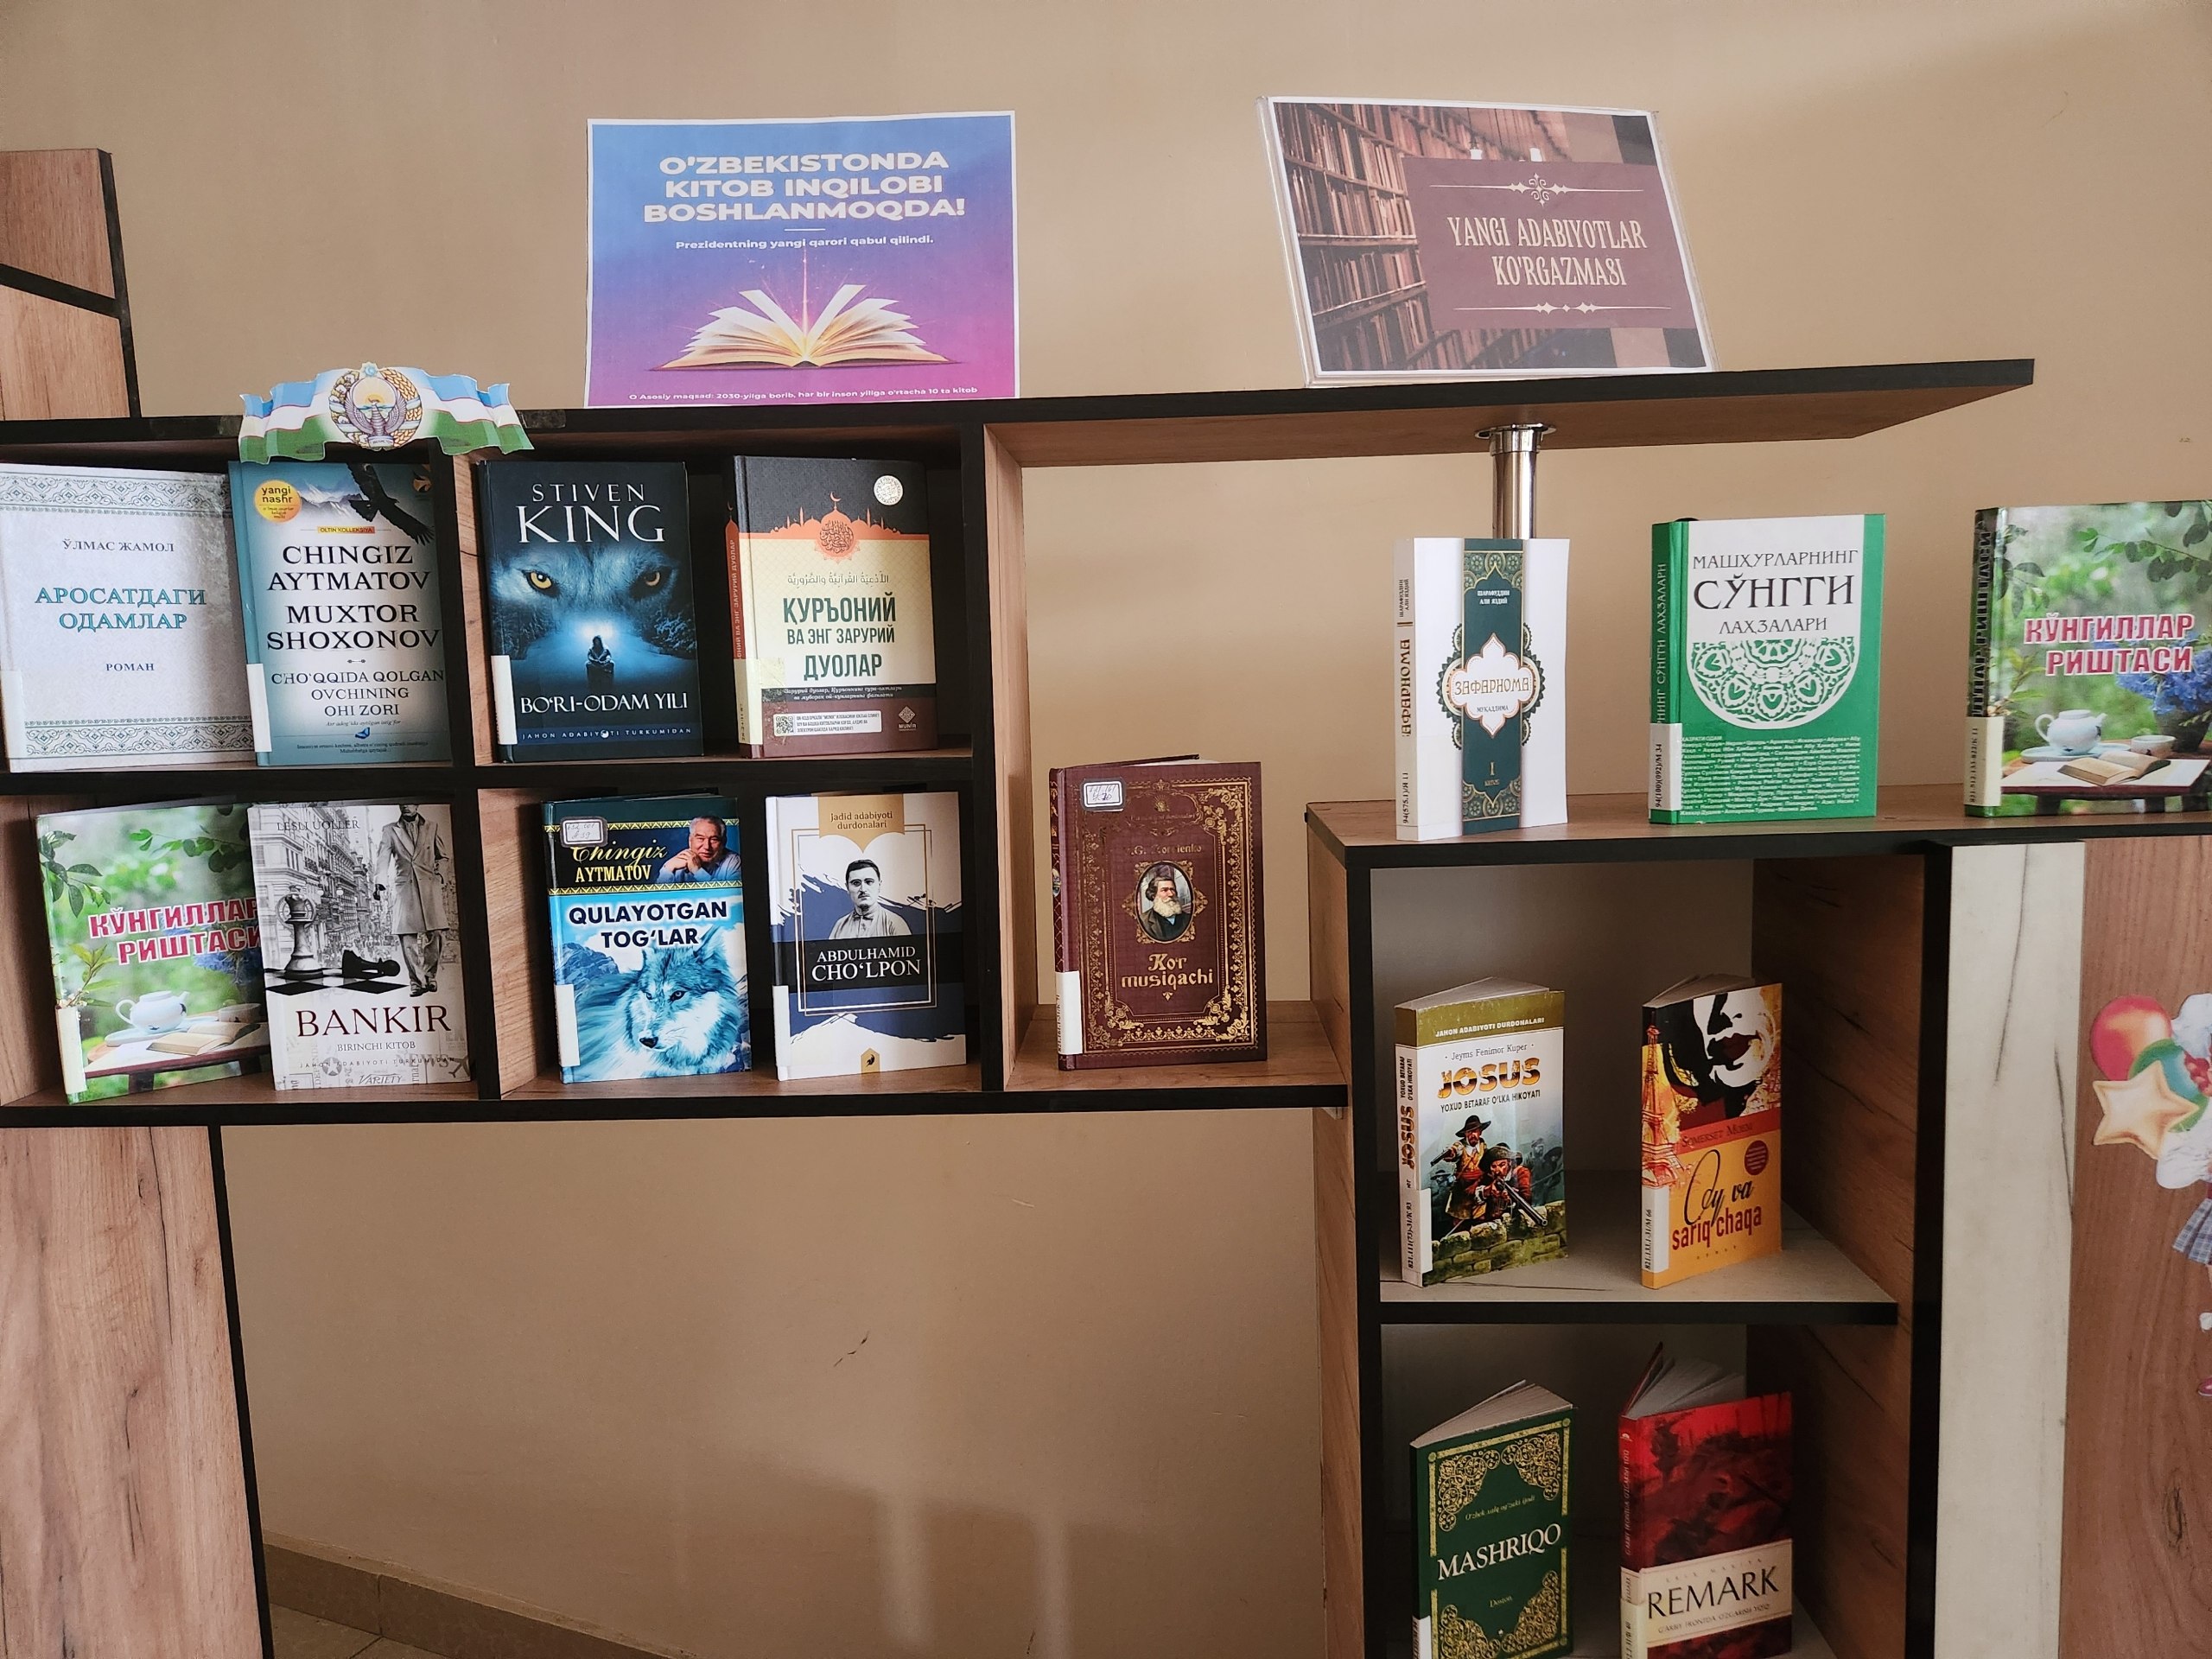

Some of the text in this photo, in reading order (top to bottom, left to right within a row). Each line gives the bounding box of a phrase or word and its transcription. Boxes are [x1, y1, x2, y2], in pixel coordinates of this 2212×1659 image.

[659, 151, 949, 175] O'ZBEKISTONDA
[665, 175, 943, 199] KITOB INQILOBI
[644, 198, 965, 223] BOSHLANMOQDA!
[676, 235, 934, 250] Prezidentning yangi qarori qabul qilindi.
[1447, 216, 1647, 249] YANGI ADABIYOTLAR
[1491, 256, 1627, 286] KO'RGAZMASI
[639, 393, 671, 402] Asosiy
[262, 486, 291, 496] yangi
[262, 494, 293, 503] nashr
[532, 484, 645, 502] STIVEN
[516, 505, 665, 543] KING
[62, 538, 175, 552] ЎЛМАС ЖАМОЛ
[283, 545, 414, 564] CHINGIZ
[267, 571, 431, 591] AYTMATOV
[1693, 572, 1855, 610] СЎНГГИ
[35, 588, 207, 608] АРОСАТДАГИ
[783, 591, 896, 625] ҚУРЪОНИЙ
[59, 613, 188, 632] ОДАМЛАР
[285, 604, 420, 624] MUXTOR
[787, 624, 895, 645] ВА ЭНГ ЗАРУРИЙ
[2024, 613, 2195, 644] КЎНГИЛЛАР
[266, 629, 442, 650] SHOXONOV
[105, 663, 155, 671] РОМАН
[804, 654, 882, 681] ДУОЛАР
[1656, 639, 1667, 686] СЎНГГИ
[2046, 646, 2194, 676] РИШТАСИ
[372, 670, 445, 683] QOLGAN
[1455, 677, 1530, 696] ЗАФАРНОМА
[311, 687, 410, 700] OVCHINING
[1400, 639, 1412, 737] АФАРНОМА
[324, 704, 400, 716] OHI ZORI
[654, 692, 688, 709] YILI
[626, 728, 692, 736] TURKUMIDAN
[1654, 743, 1662, 753] 34
[276, 821, 308, 830] LESLI
[837, 821, 887, 830] durdonalari
[855, 811, 893, 821] adabiyoti
[575, 865, 652, 882] AYTMATOV
[88, 897, 257, 938] КЎНГИЛЛАР
[569, 901, 727, 925] QULAYOTGAN
[118, 925, 260, 965] РИШТАСИ
[817, 946, 916, 963] ABDULHAMID
[1122, 967, 1214, 992] musiqachi
[296, 1005, 451, 1037] BANKIR
[1435, 1017, 1545, 1037] JAHON ADABIYOTI DURDONALARI
[337, 1041, 416, 1052] BIRINCHI KITOB
[1451, 1044, 1528, 1061] Jeyms Fenimor Kuper
[1437, 1057, 1541, 1099] JOSUS
[1440, 1102, 1462, 1113] YOXUD
[1464, 1097, 1491, 1109] BETARAF
[1511, 1090, 1541, 1102] HIKOYATI
[1401, 1105, 1415, 1170] JOSUS
[1732, 1180, 1755, 1202] va
[1672, 1206, 1762, 1250] sariq chaqa
[1437, 1522, 1561, 1581] MASHRIQO
[1648, 1566, 1780, 1619] REMARK
